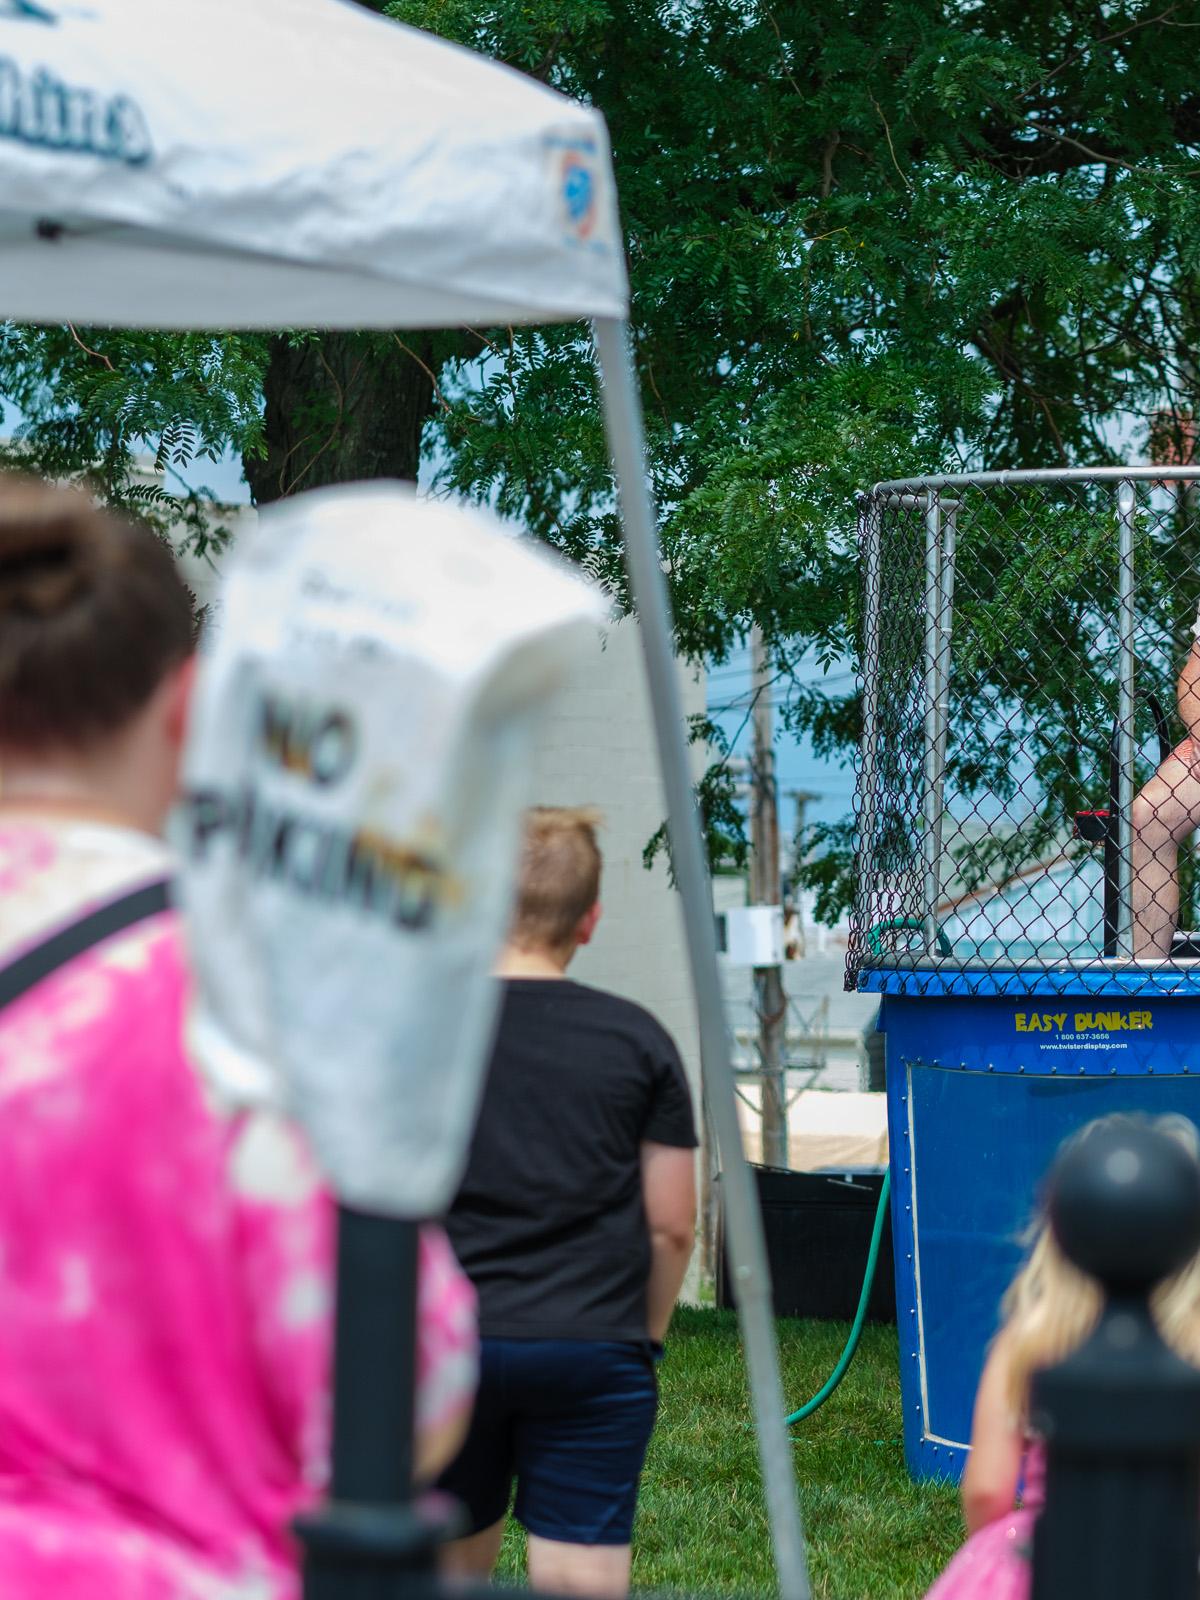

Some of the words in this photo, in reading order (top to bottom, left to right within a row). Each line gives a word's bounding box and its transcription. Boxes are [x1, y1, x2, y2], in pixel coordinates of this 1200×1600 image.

[257, 692, 358, 792] NO
[1015, 1012, 1067, 1032] EASY
[1074, 1010, 1153, 1032] DUNKER
[1040, 1042, 1128, 1051] www.twisterdisplay.com
